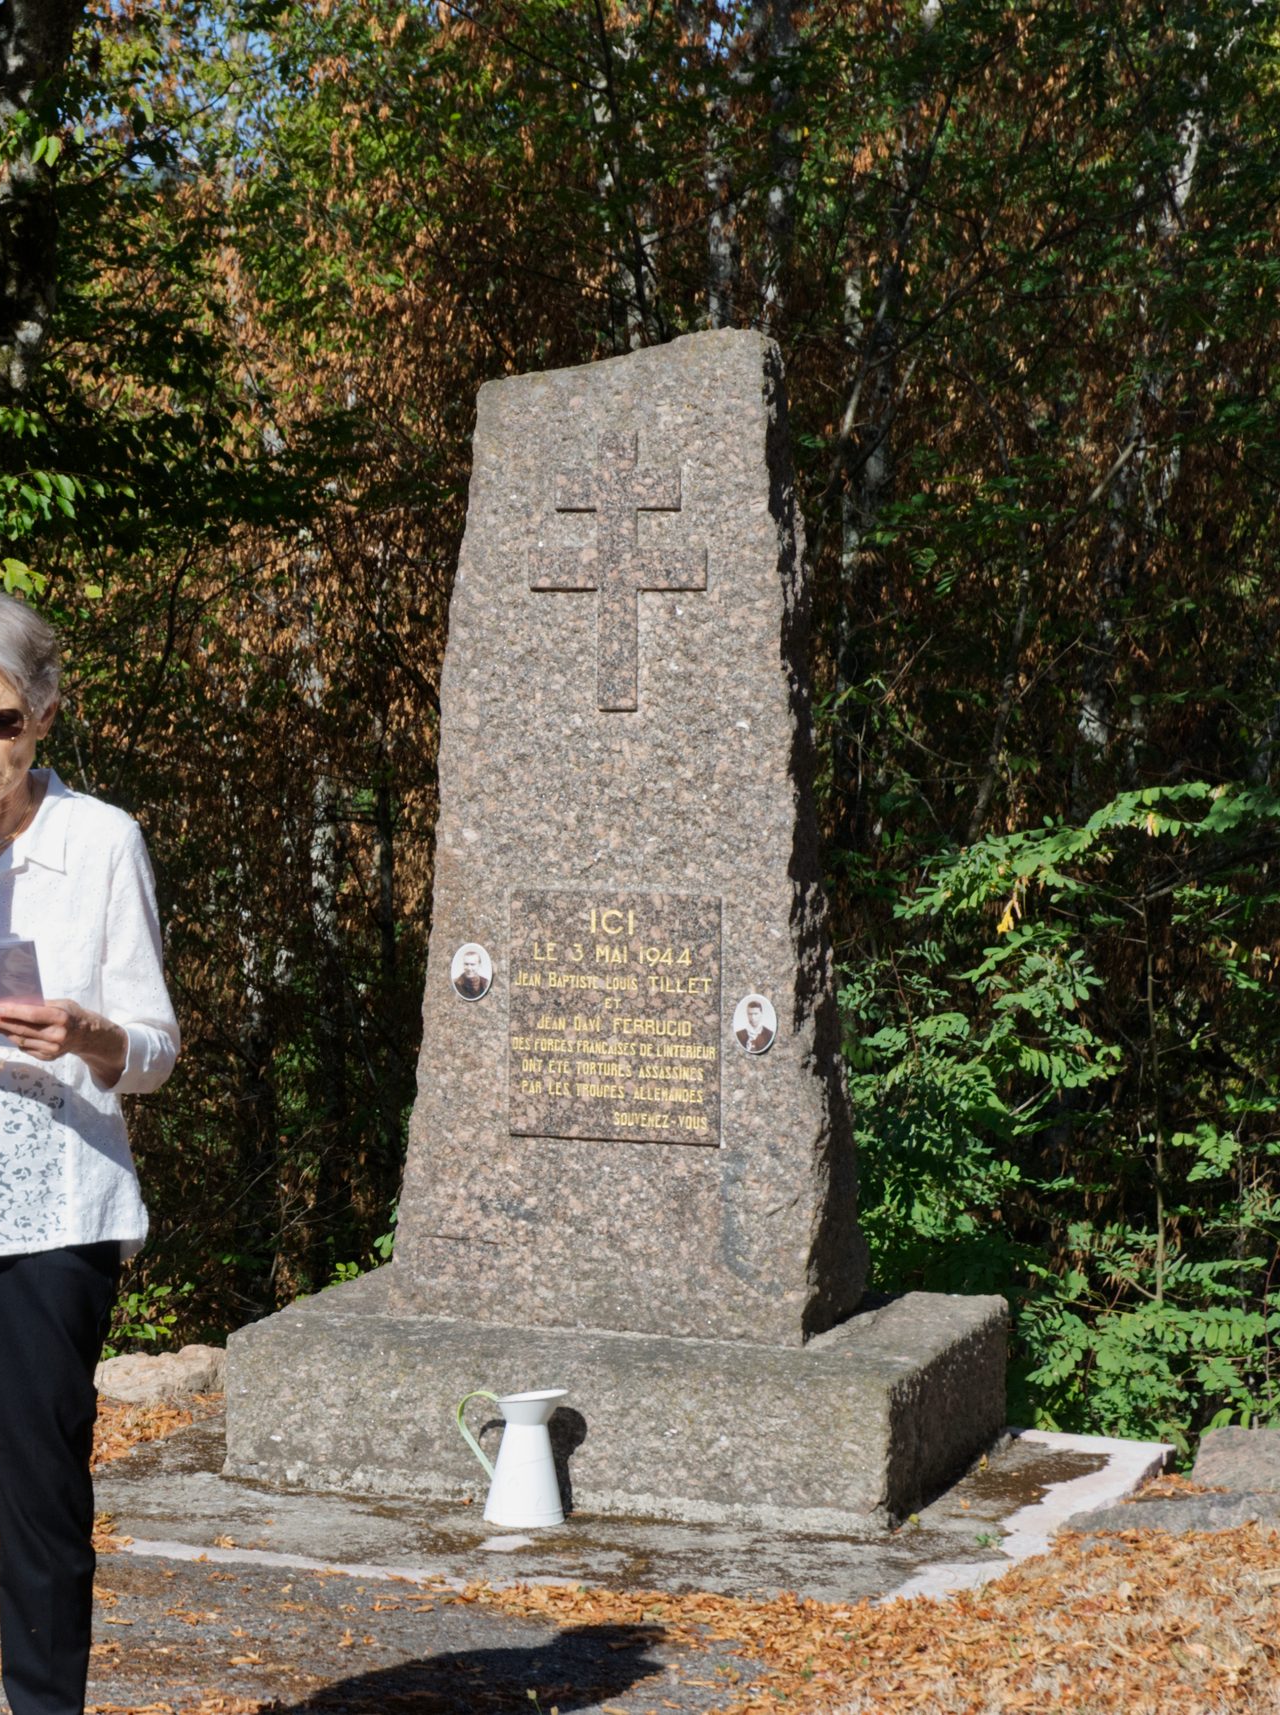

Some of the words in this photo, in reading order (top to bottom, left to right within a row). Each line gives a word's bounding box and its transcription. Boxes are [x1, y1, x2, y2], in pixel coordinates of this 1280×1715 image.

[591, 909, 634, 935] ICI
[534, 942, 557, 960] LE
[573, 944, 583, 961] 3
[596, 945, 627, 963] MAI
[640, 947, 692, 966] 1944
[648, 976, 712, 994] TILLET
[605, 999, 621, 1008] ET
[512, 1037, 531, 1050] DES
[535, 1039, 573, 1052] FORCES
[640, 1043, 653, 1056] DE
[522, 1059, 543, 1072] ONT
[522, 1081, 542, 1094] PAR
[549, 1082, 569, 1095] LES
[576, 1083, 625, 1099] TROUPES
[634, 1086, 703, 1103] ALLEMANDES
